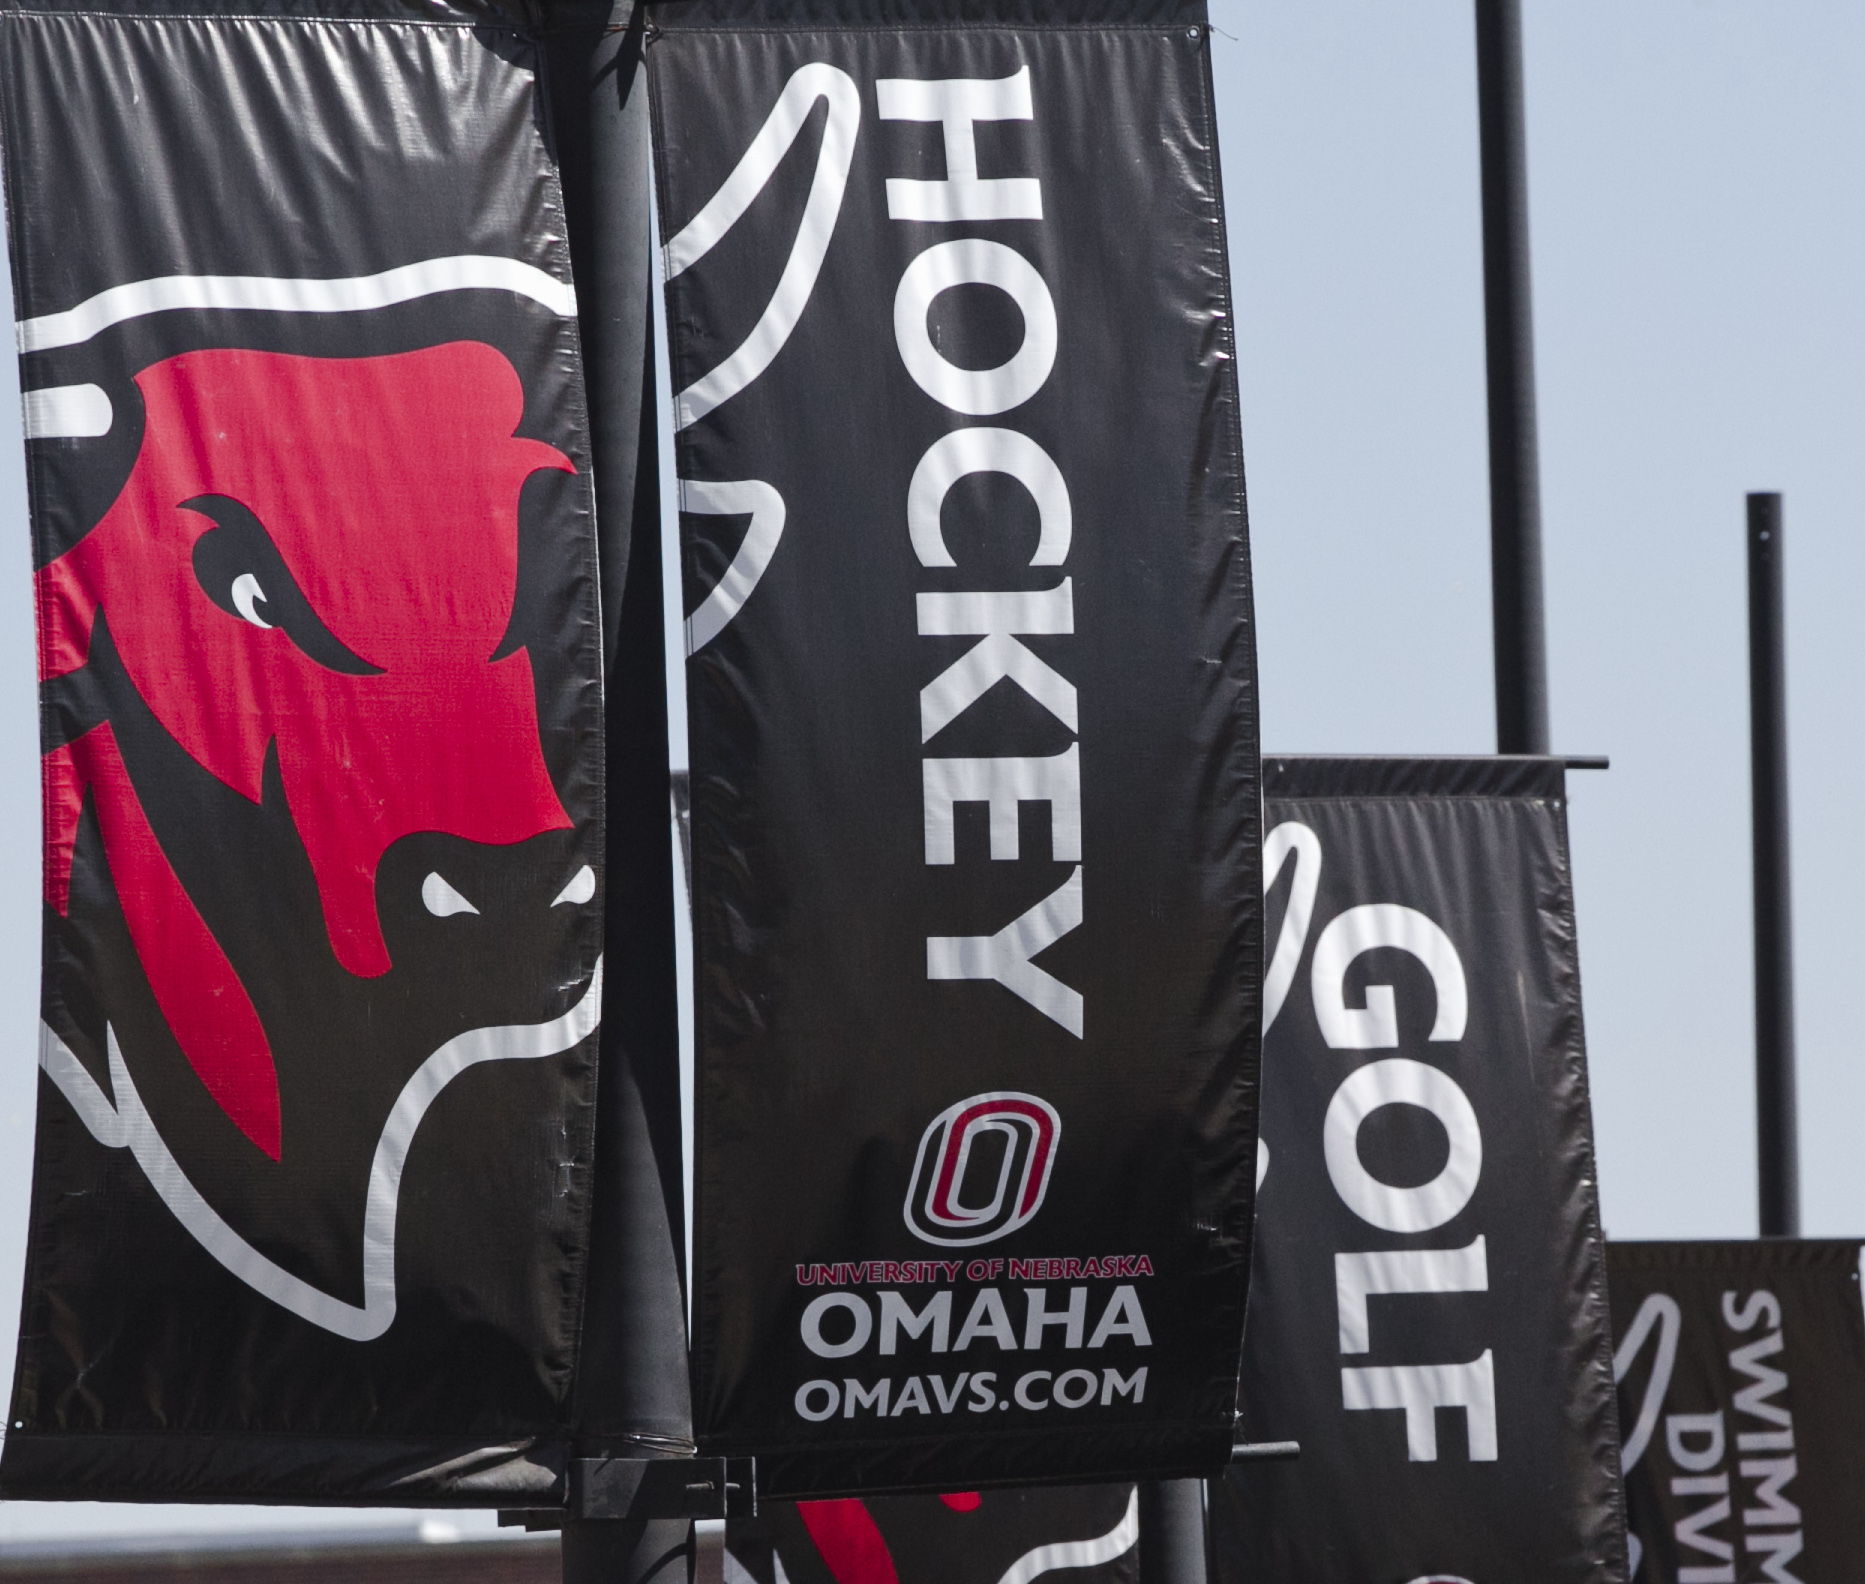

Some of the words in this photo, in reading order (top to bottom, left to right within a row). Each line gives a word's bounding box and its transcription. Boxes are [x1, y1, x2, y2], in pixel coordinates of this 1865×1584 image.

[876, 64, 1086, 1040] HOCKEY
[1310, 904, 1498, 1462] GOLF
[796, 1260, 962, 1285] UNIVERSITY
[967, 1258, 1003, 1280] OF
[1008, 1255, 1154, 1280] NEBRASKA
[800, 1285, 1152, 1358] OMAHA
[794, 1366, 1149, 1422] OMAVS.COM
[1666, 1409, 1735, 1584] DIVI
